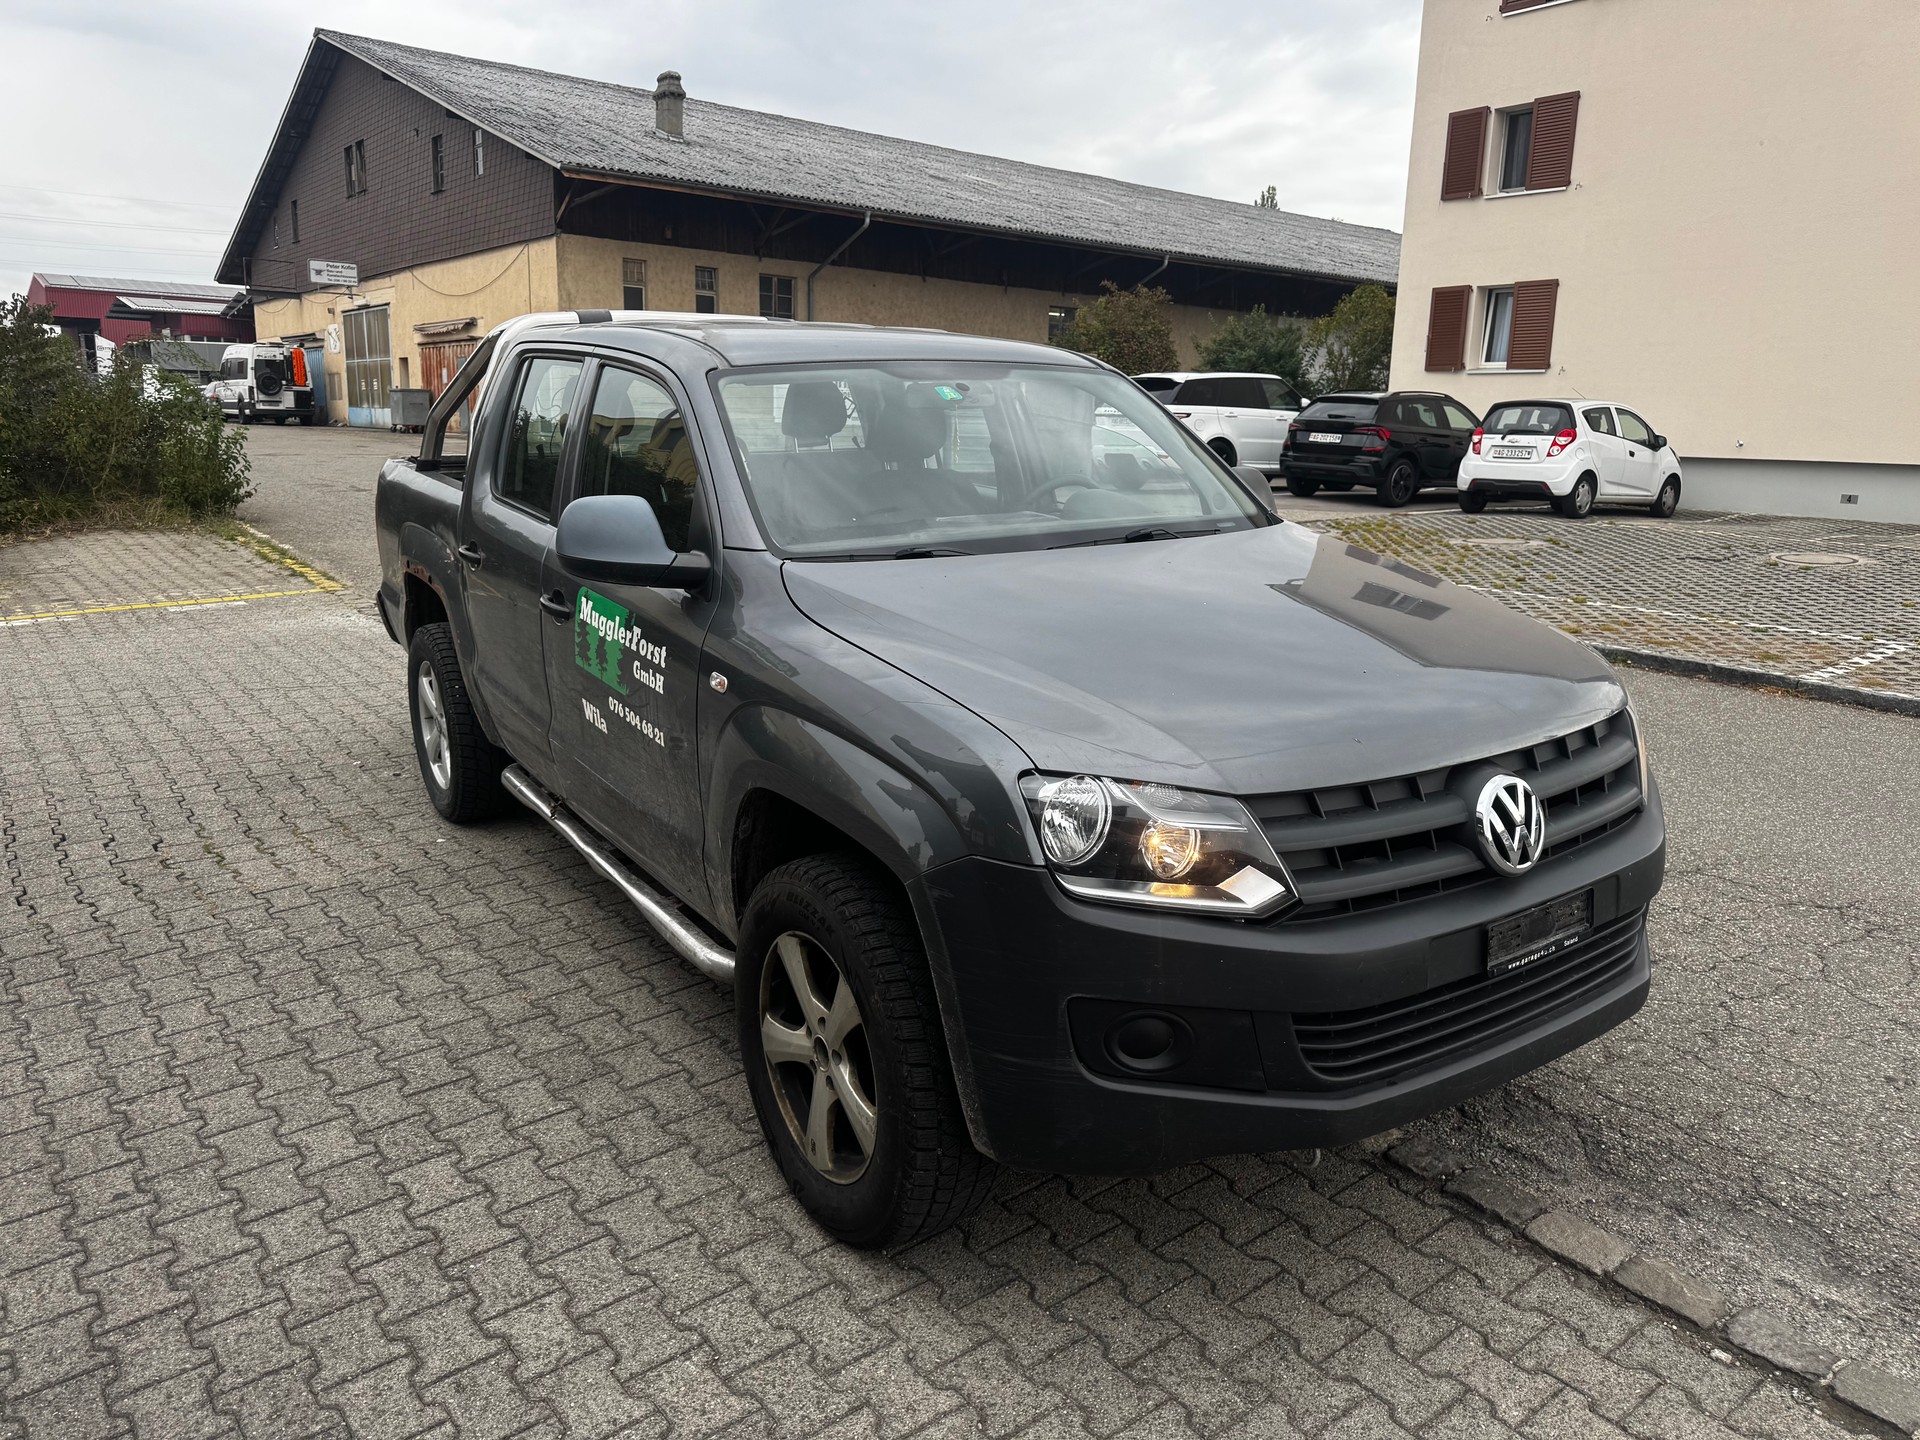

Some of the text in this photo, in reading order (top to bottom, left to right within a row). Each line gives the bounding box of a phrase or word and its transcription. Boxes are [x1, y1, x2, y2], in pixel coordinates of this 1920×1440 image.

[633, 660, 664, 695] GmbH
[582, 698, 608, 735] Wila
[608, 696, 665, 748] 076 504 68 21
[786, 891, 835, 938] BLIZZAK
